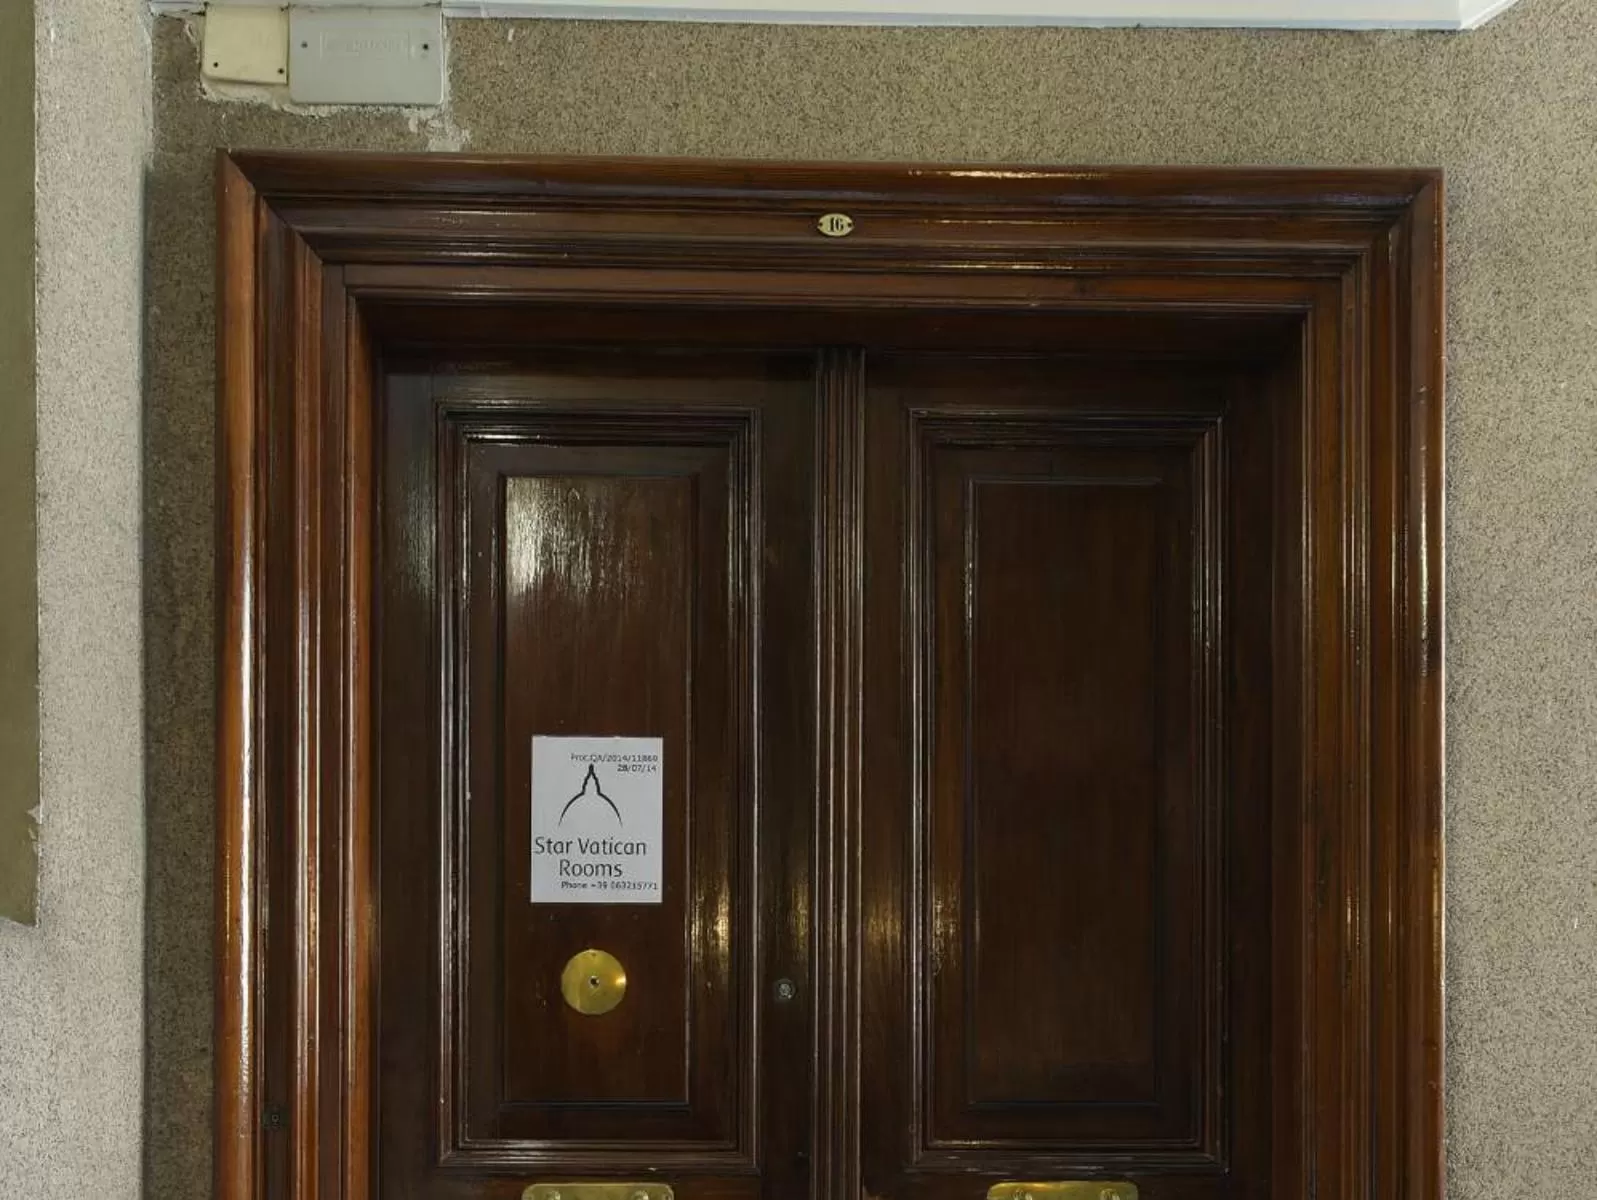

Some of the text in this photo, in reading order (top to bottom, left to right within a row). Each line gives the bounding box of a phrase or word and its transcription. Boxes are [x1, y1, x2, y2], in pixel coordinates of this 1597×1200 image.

[830, 216, 844, 232] 16
[535, 836, 647, 856] Star Vatican
[559, 858, 623, 878] Rooms
[561, 881, 588, 890] Phone
